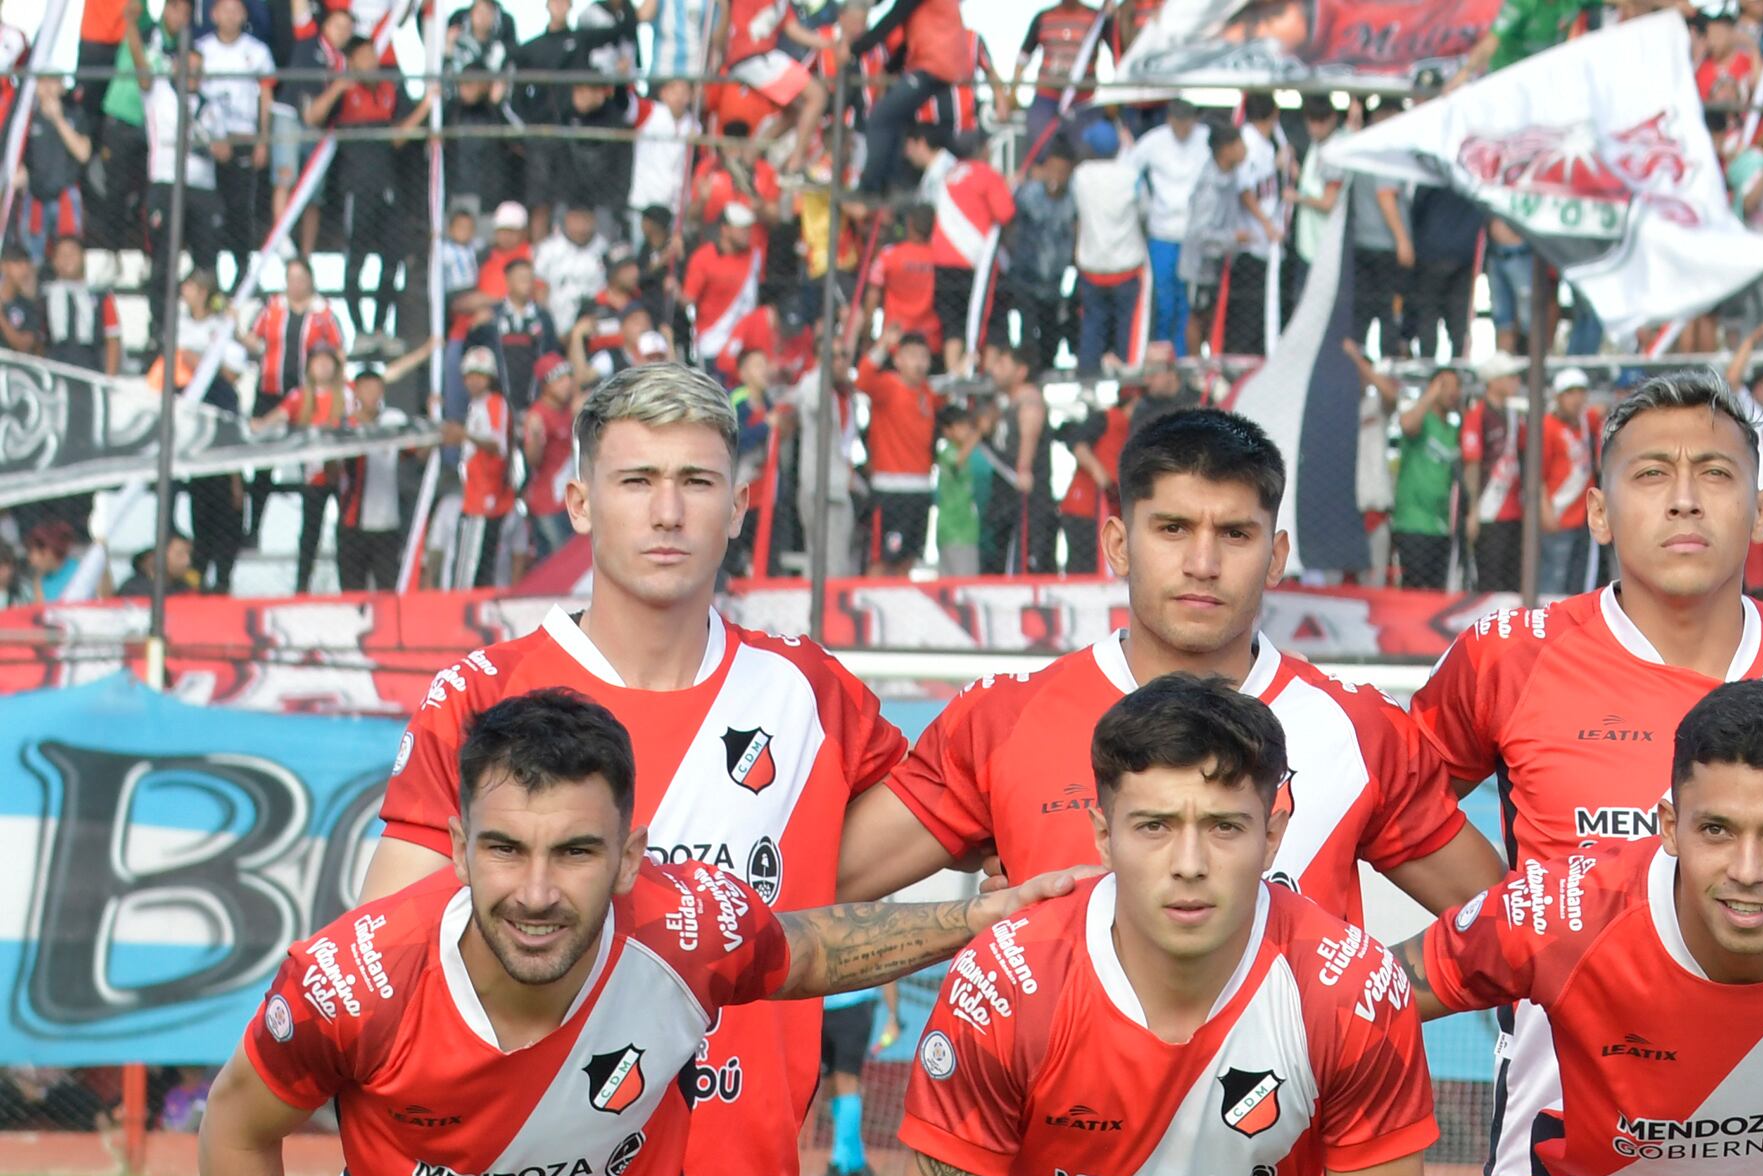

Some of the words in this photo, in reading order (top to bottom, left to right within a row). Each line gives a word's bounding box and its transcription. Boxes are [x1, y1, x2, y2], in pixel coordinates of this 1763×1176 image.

[1577, 728, 1655, 742] LEATIX
[1041, 797, 1097, 816] LEAT
[1316, 936, 1340, 960] El
[305, 937, 361, 1018] Vitamina
[302, 965, 337, 1019] Vida
[1602, 1043, 1677, 1061] LEATIX
[600, 1058, 632, 1099] CDM
[1232, 1083, 1270, 1119] CDM
[1044, 1115, 1124, 1131] LEATIX
